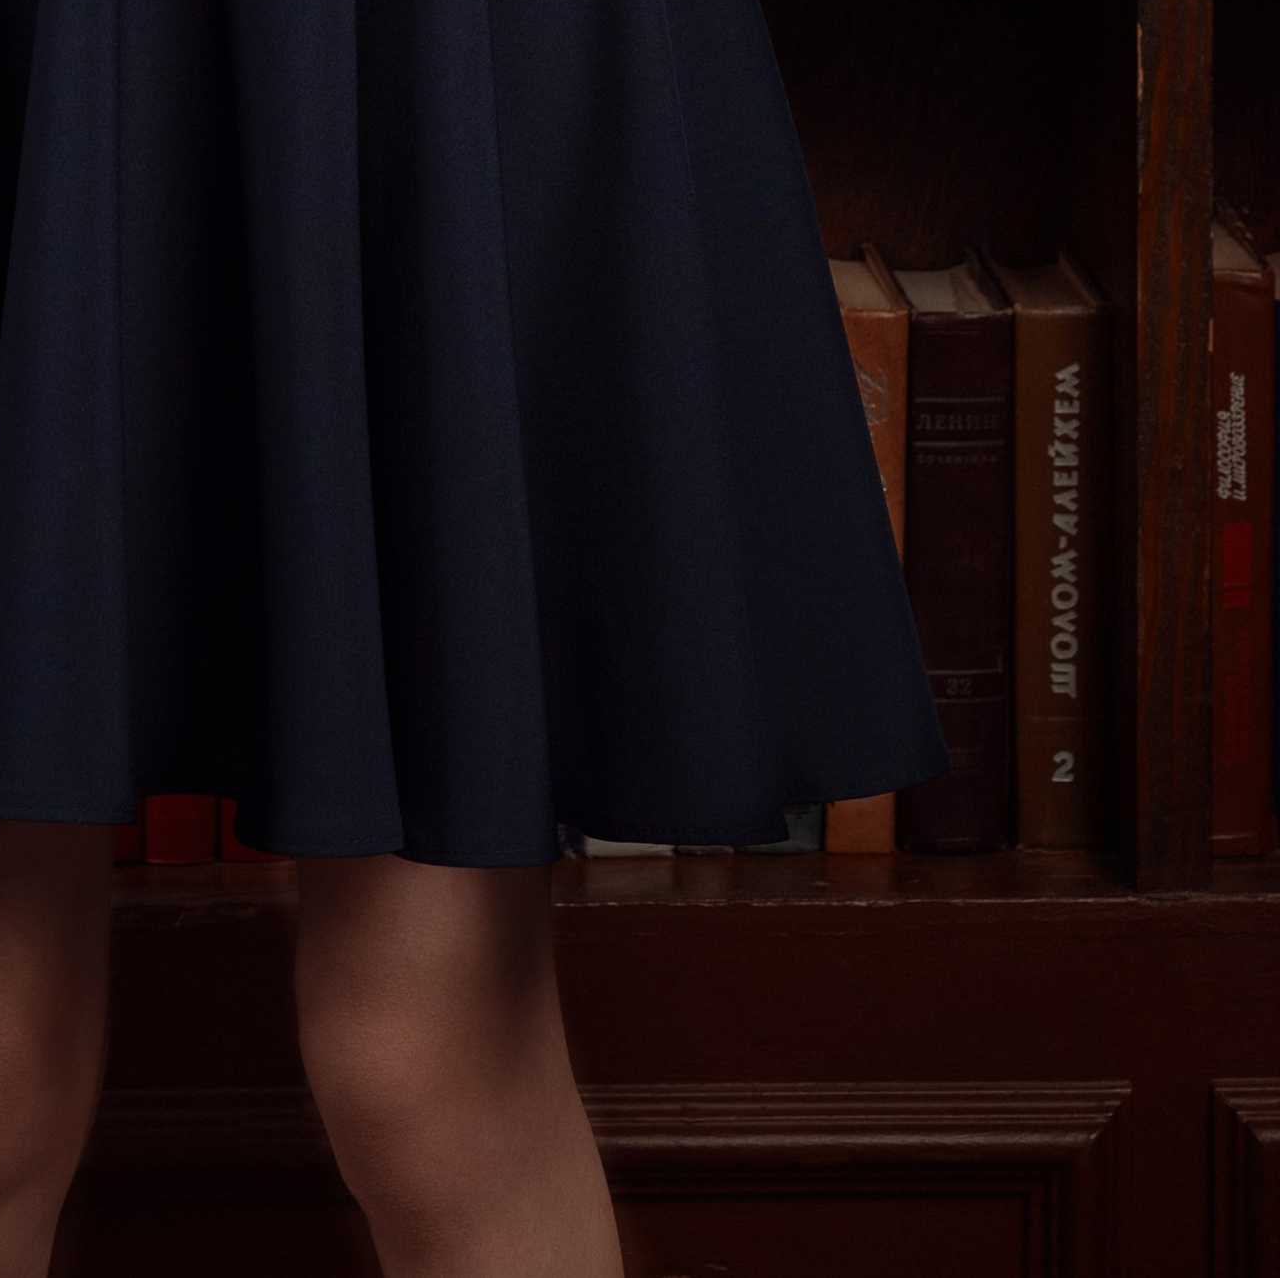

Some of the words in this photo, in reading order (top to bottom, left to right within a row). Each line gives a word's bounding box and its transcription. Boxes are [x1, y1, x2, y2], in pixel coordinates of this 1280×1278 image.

[915, 412, 1000, 432] ЛЕНИН
[1046, 362, 1081, 700] ШОЛОМ-АЛЕЙХЕМ
[945, 676, 975, 696] 32
[1050, 749, 1077, 784] 2
